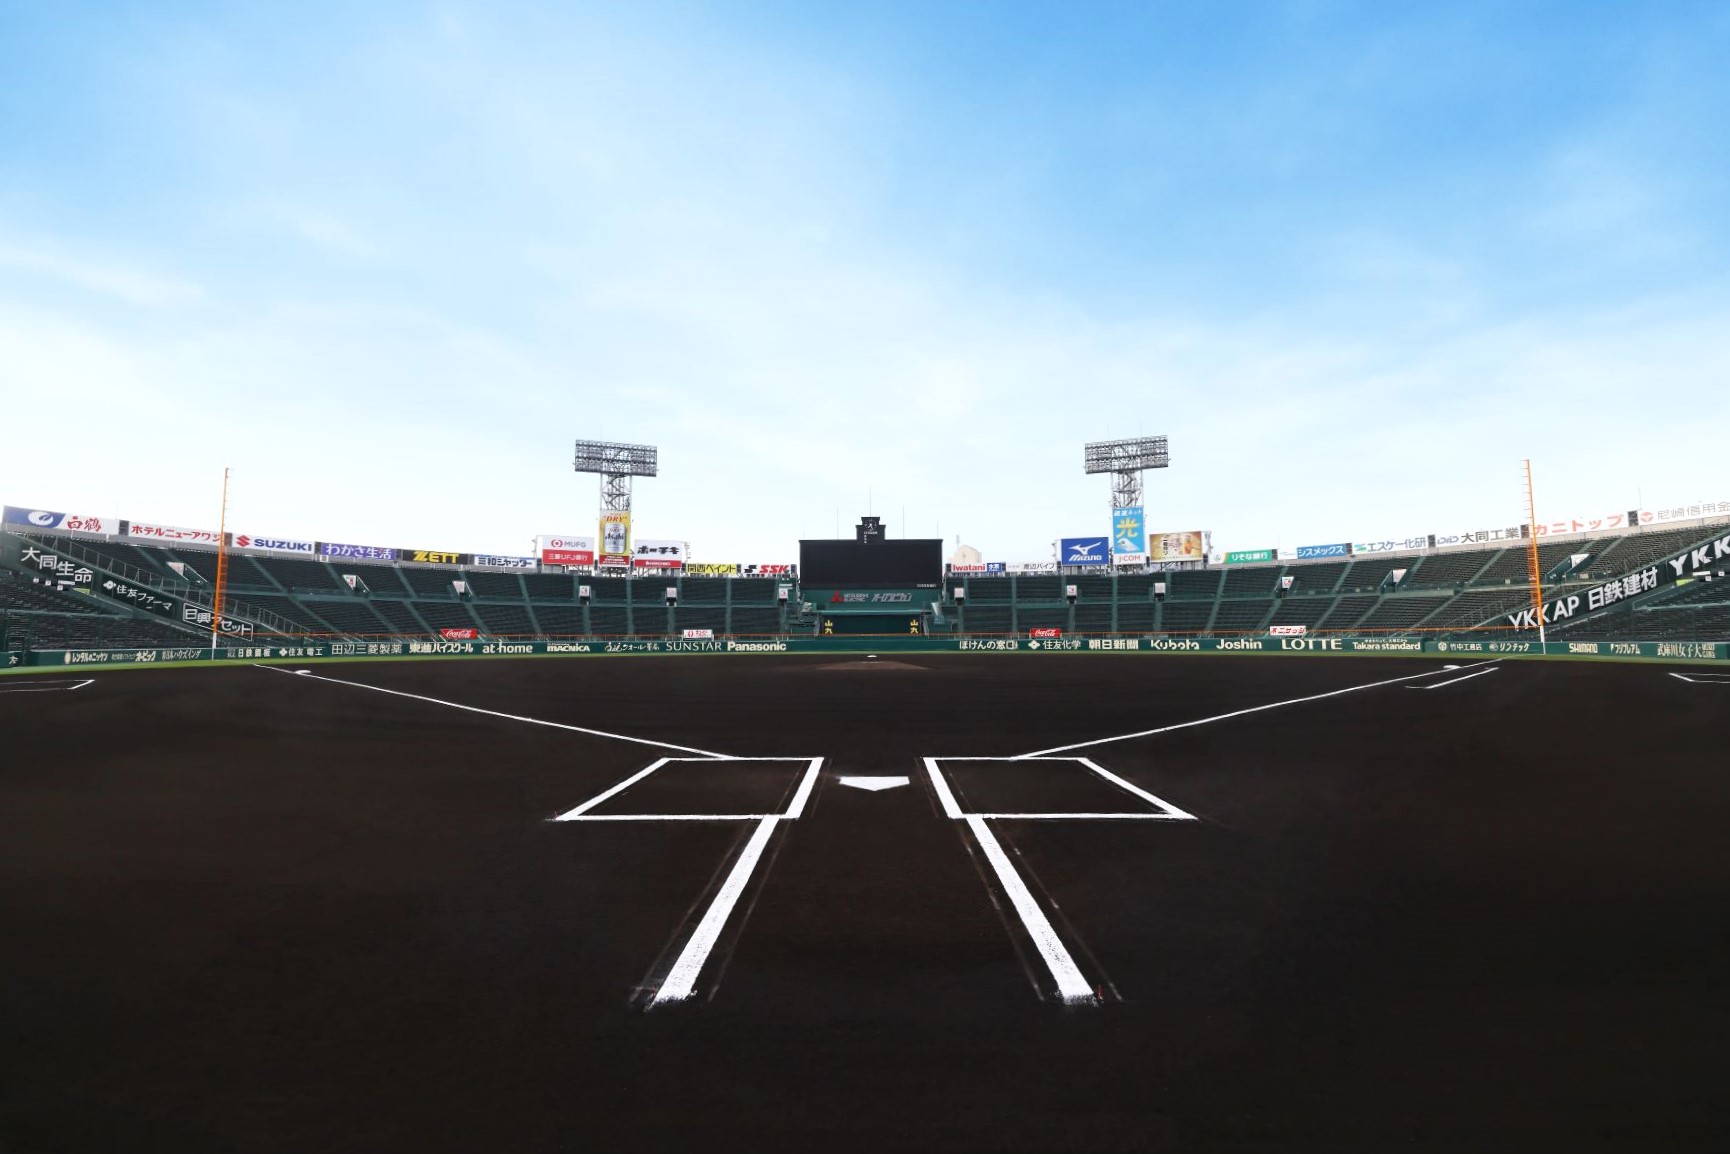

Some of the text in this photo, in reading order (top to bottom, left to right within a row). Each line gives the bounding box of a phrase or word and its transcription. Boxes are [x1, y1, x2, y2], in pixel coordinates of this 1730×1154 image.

[67, 516, 102, 532] 白鶴
[1116, 518, 1140, 538] 光
[1535, 514, 1624, 535] カニトップ
[131, 525, 221, 542] ホテルニューアワジ
[1461, 527, 1520, 543] 大同工業
[254, 538, 312, 551] SUZUKI
[1368, 537, 1426, 551] エスケー化研
[325, 543, 392, 559] わかさ生活
[1232, 552, 1268, 560] りそな銀行
[1299, 546, 1344, 557] シスメックス
[413, 550, 459, 564] ZETT
[479, 557, 532, 567] 三和シャッター
[21, 547, 93, 583] 大同生命
[688, 564, 736, 573] 関西ペイント
[759, 564, 789, 573] SSK
[1588, 567, 1658, 611] 日鉄建材
[117, 585, 172, 611] 住友ファーマ
[1509, 596, 1579, 631] YKK AP
[446, 629, 472, 638] Coca-Cola
[1035, 629, 1056, 637] Coca-Cola
[331, 643, 402, 655] 田辺三菱製薬
[409, 642, 473, 653] 東進ハイスクール
[666, 641, 721, 651] SUNSTAR
[727, 640, 787, 651] Panasonic
[960, 640, 1016, 650] ほけんの窓口
[1043, 640, 1081, 650] 住友化学
[1089, 640, 1138, 650] 朝日新聞
[1151, 639, 1199, 650] Kubota
[1216, 638, 1262, 650] Joshin
[1281, 638, 1342, 650] LOTTE
[1352, 642, 1420, 650] Takara standard
[1450, 643, 1483, 651] 竹中工務店
[1500, 643, 1529, 652] リンテック
[1568, 643, 1598, 653] SHIMANO
[72, 652, 108, 662] レンタルのニッケン
